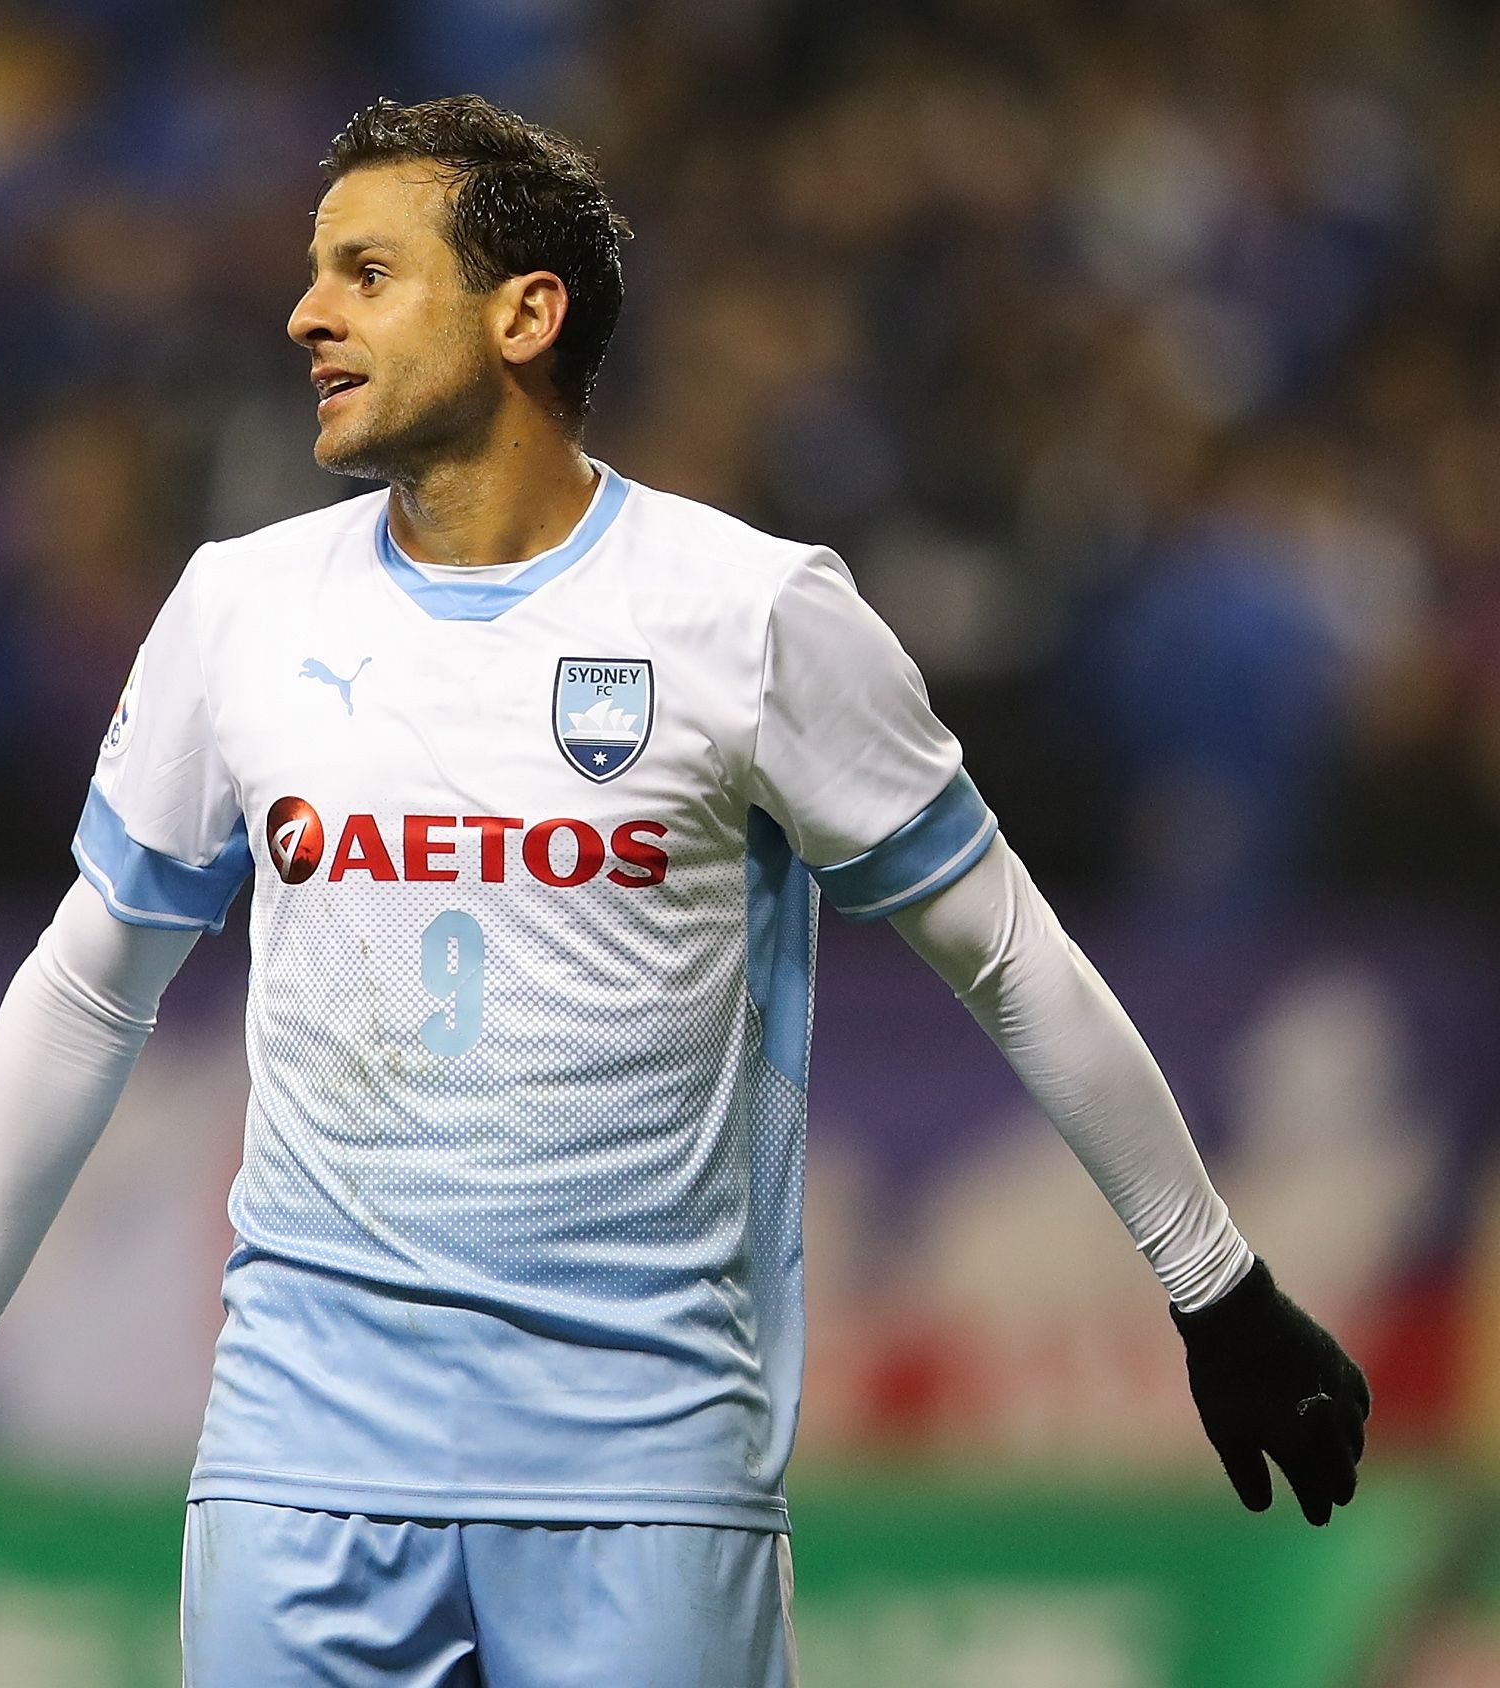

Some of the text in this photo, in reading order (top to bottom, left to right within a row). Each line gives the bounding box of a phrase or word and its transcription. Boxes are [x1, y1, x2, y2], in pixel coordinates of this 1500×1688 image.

[567, 667, 641, 685] SYDNEY
[596, 685, 613, 697] FC
[328, 813, 670, 888] AETOS
[419, 909, 485, 1058] 9
